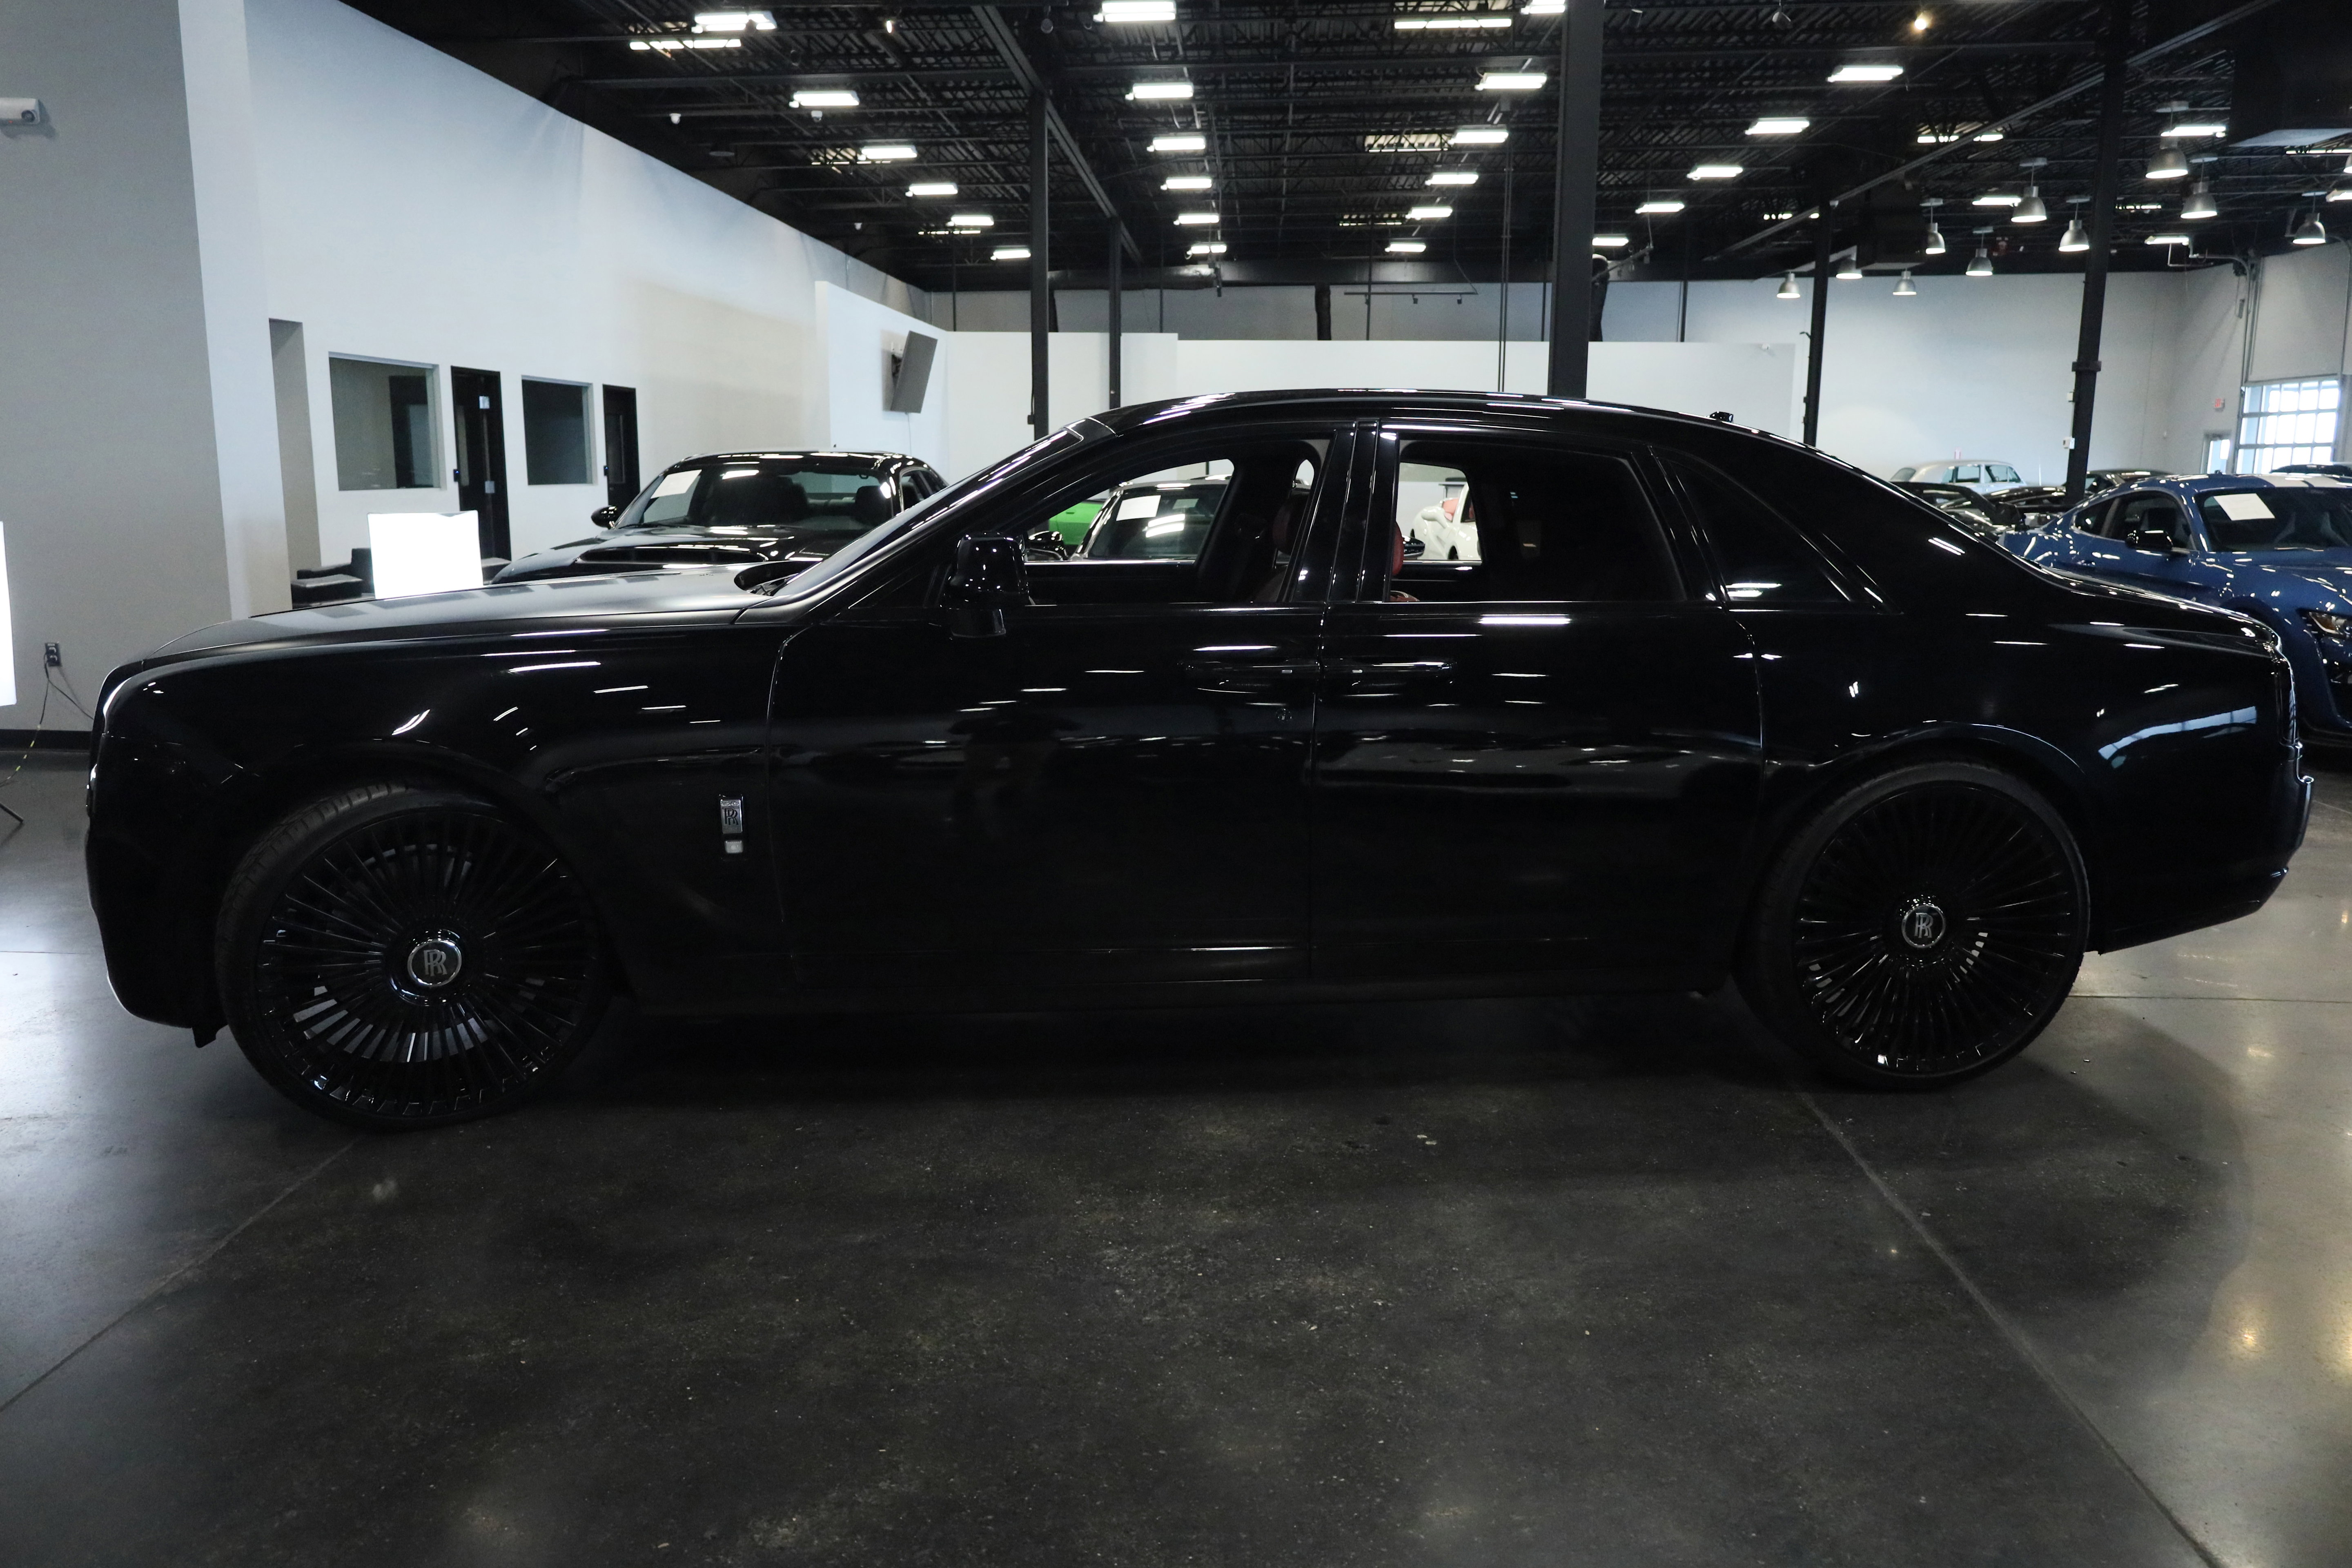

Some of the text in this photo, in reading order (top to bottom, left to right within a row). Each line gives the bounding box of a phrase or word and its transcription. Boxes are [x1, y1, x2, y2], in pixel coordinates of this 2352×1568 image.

[724, 808, 738, 825] RR
[1914, 913, 1933, 938] RR
[423, 949, 447, 976] RR
